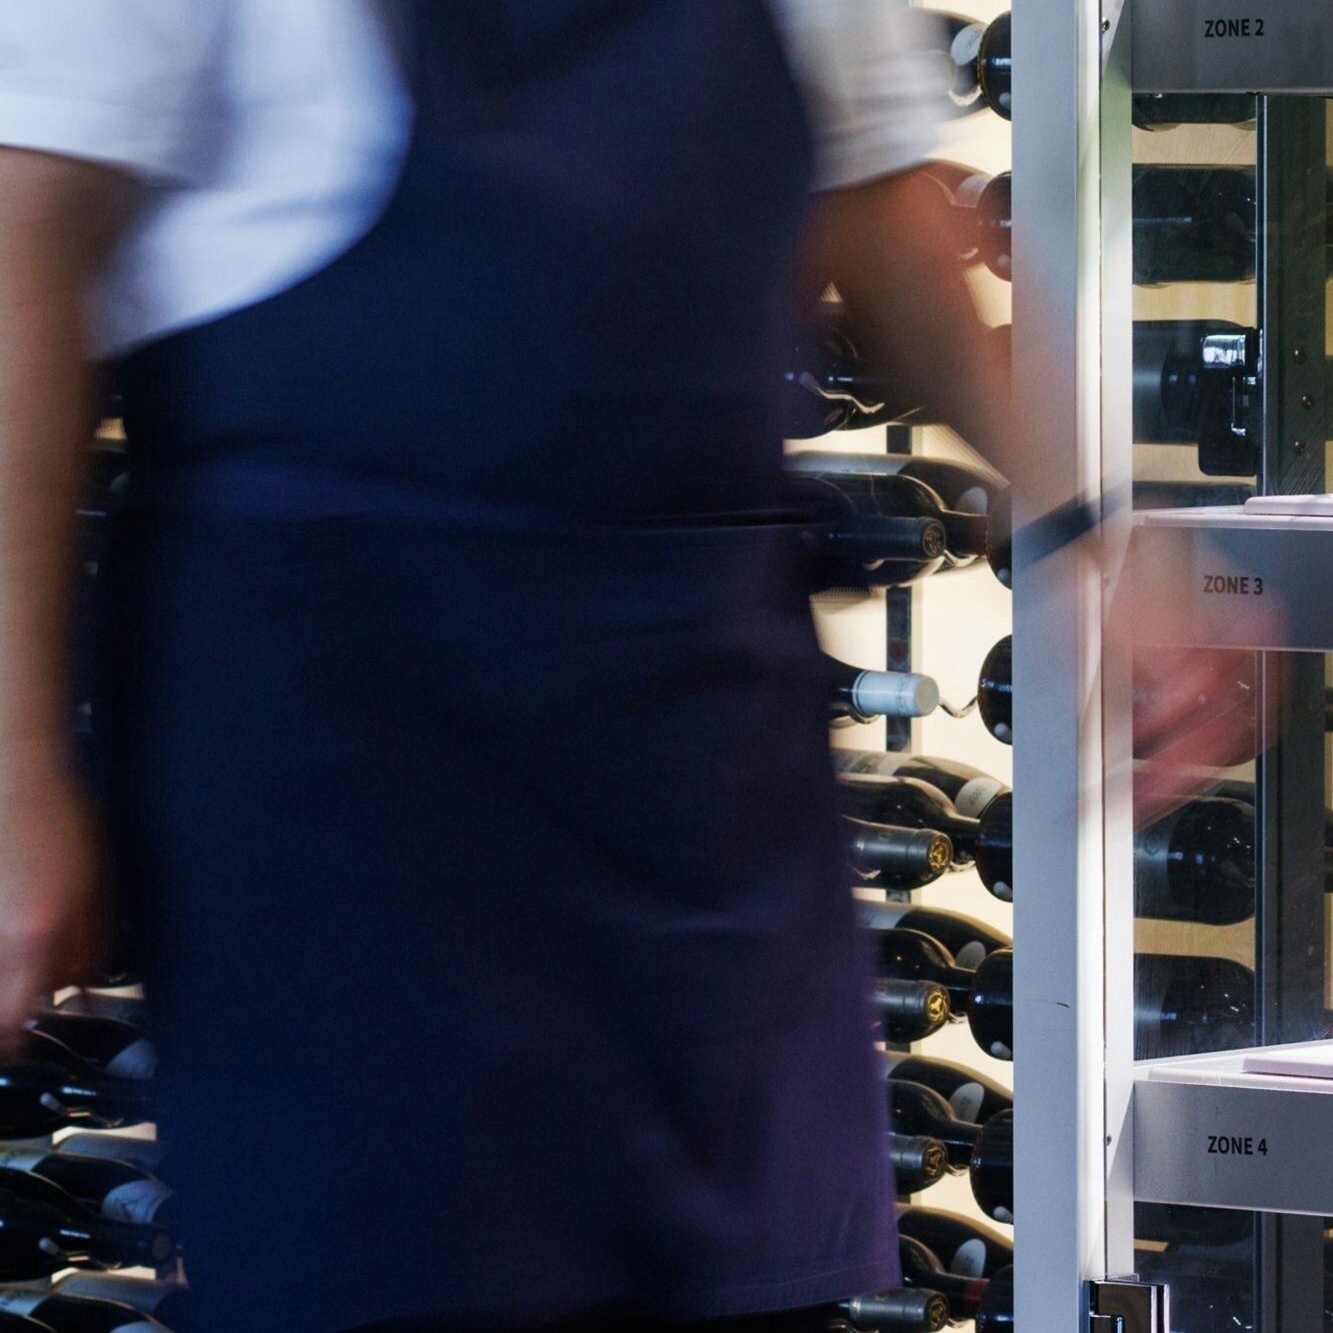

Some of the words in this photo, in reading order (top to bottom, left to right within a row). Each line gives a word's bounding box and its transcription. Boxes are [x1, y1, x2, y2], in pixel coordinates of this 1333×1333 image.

[1204, 18, 1251, 38] ZONE
[1254, 18, 1265, 36] 2
[1203, 575, 1250, 595] ZONE
[1253, 577, 1264, 596] 3
[1207, 1135, 1254, 1155] ZONE
[1257, 1138, 1268, 1156] 4
